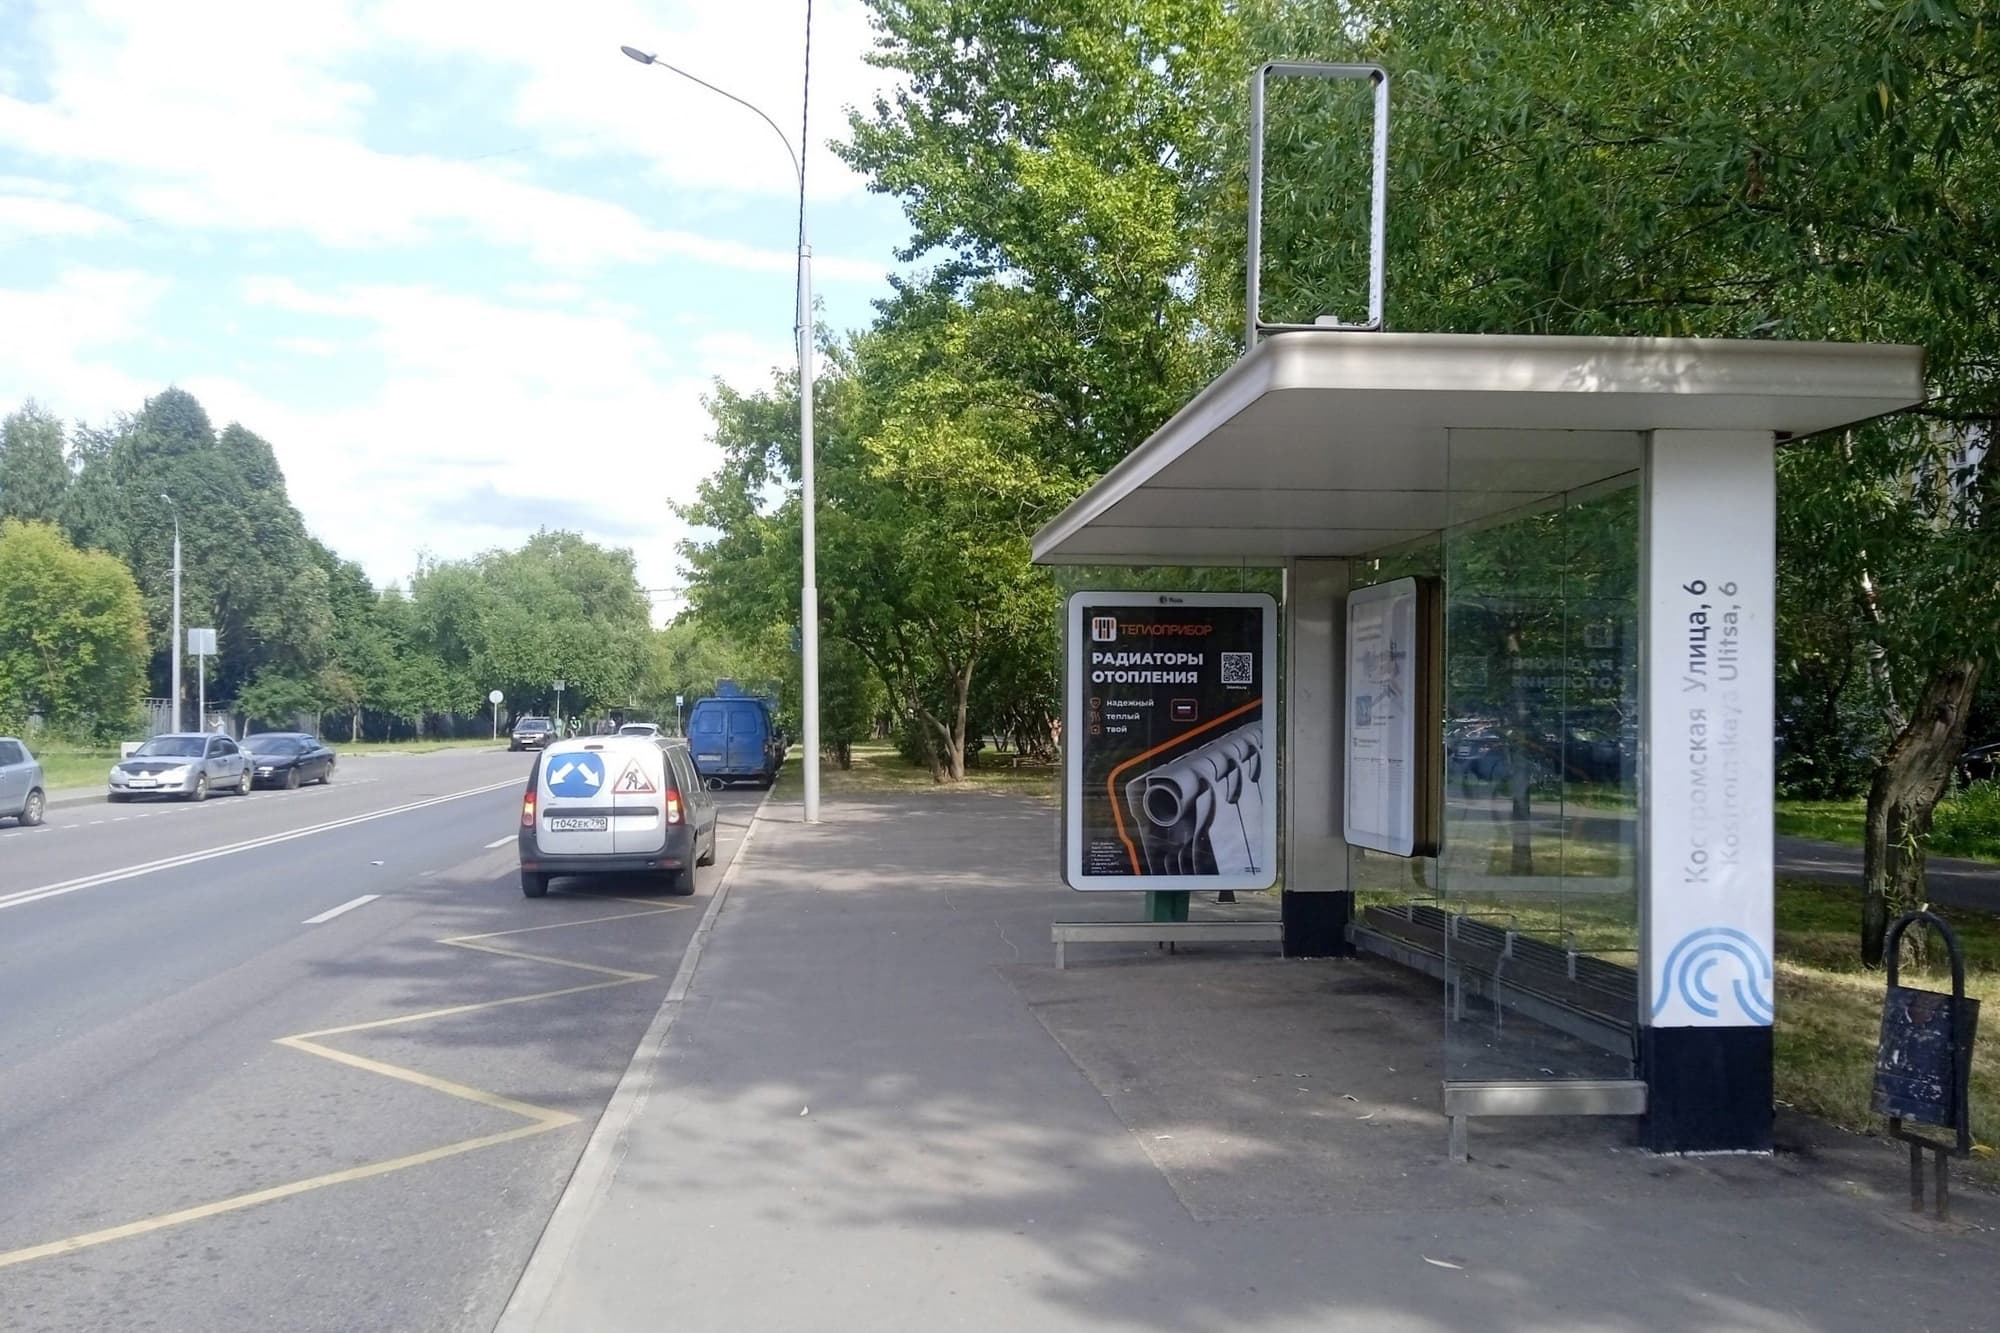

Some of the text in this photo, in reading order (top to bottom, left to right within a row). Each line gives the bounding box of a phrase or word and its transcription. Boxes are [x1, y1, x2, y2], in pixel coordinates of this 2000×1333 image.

[1682, 580, 1706, 596] 6
[1719, 581, 1738, 597] 6
[1119, 624, 1213, 636] ТЕПЛОПРИБОР
[1682, 604, 1712, 693] Улица,
[1718, 605, 1741, 682] Ulitsa,
[1092, 652, 1204, 666] РАДИАТОРЫ
[1091, 670, 1198, 684] ОТОПЛЕНИЯ
[1106, 698, 1154, 708] надежный
[1106, 712, 1140, 722] теплый
[1106, 725, 1127, 734] твой
